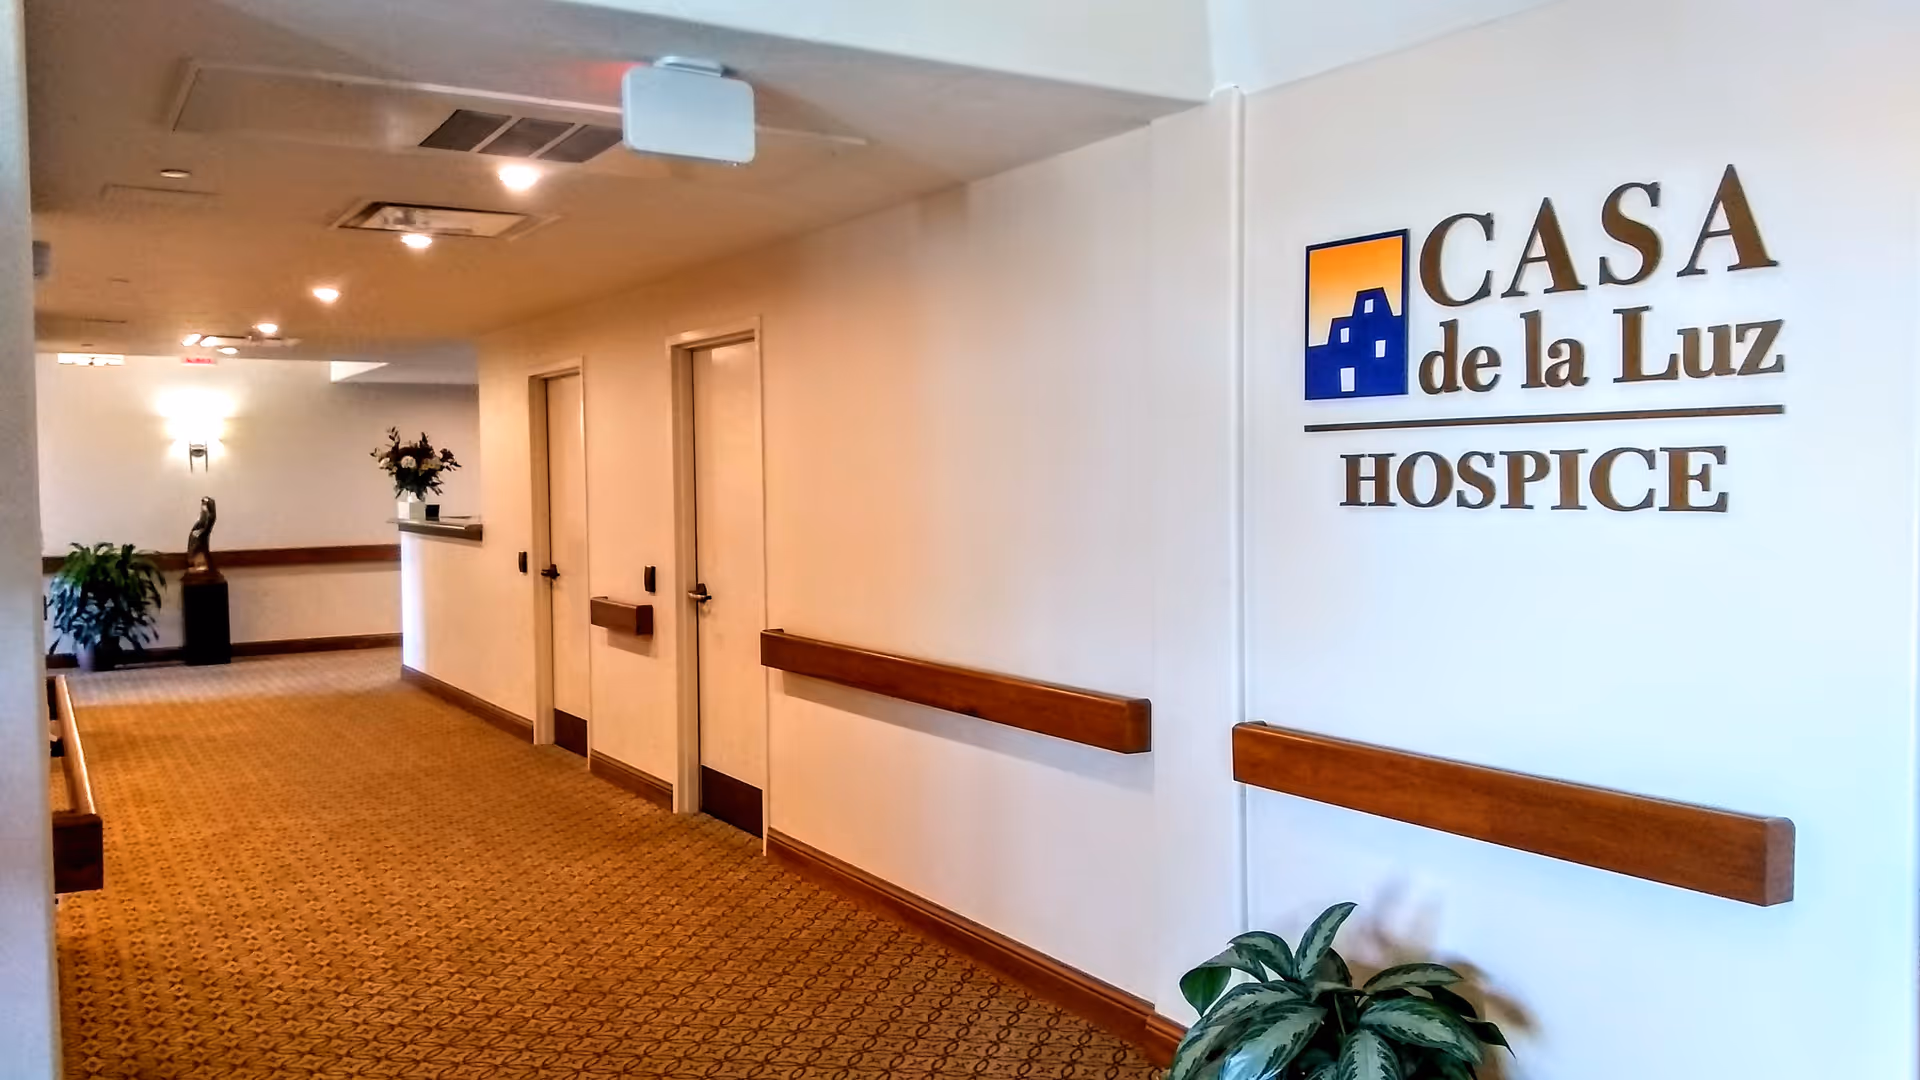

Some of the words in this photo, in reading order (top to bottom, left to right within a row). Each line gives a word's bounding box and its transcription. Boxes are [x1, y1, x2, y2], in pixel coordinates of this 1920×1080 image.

[1419, 164, 1778, 307] CASA
[1418, 319, 1502, 395] de
[1520, 310, 1589, 389] la
[1613, 306, 1785, 383] Luz
[1340, 445, 1728, 513] HOSPICE
